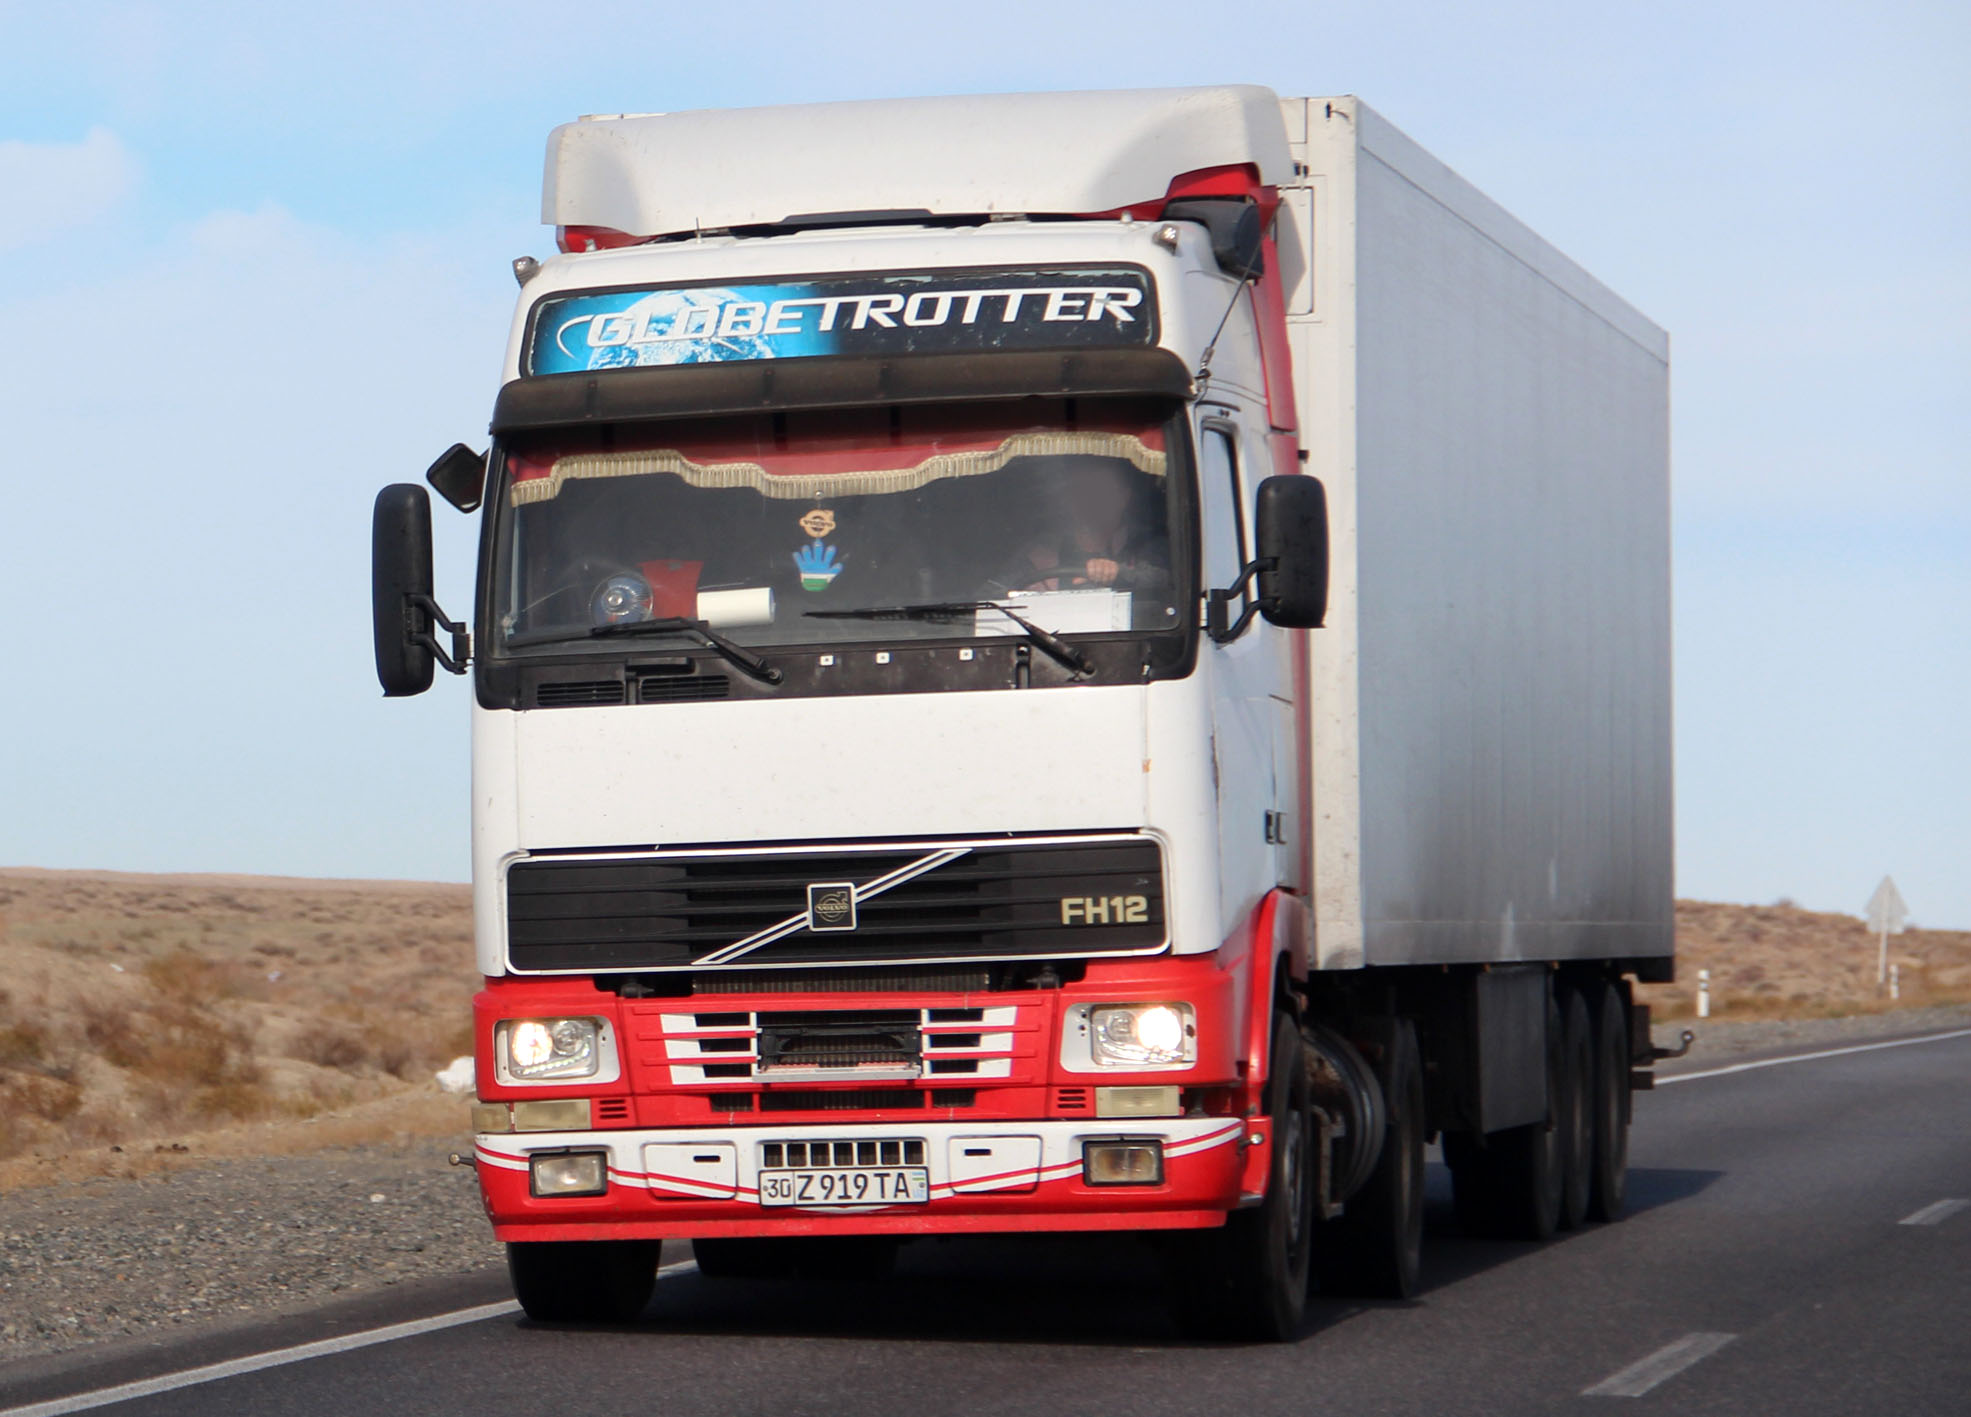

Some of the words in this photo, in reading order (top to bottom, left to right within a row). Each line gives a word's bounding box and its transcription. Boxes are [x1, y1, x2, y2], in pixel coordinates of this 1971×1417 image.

[585, 287, 1143, 348] GLOBETROTTER
[1061, 896, 1149, 925] FH12
[767, 1178, 792, 1199] 30
